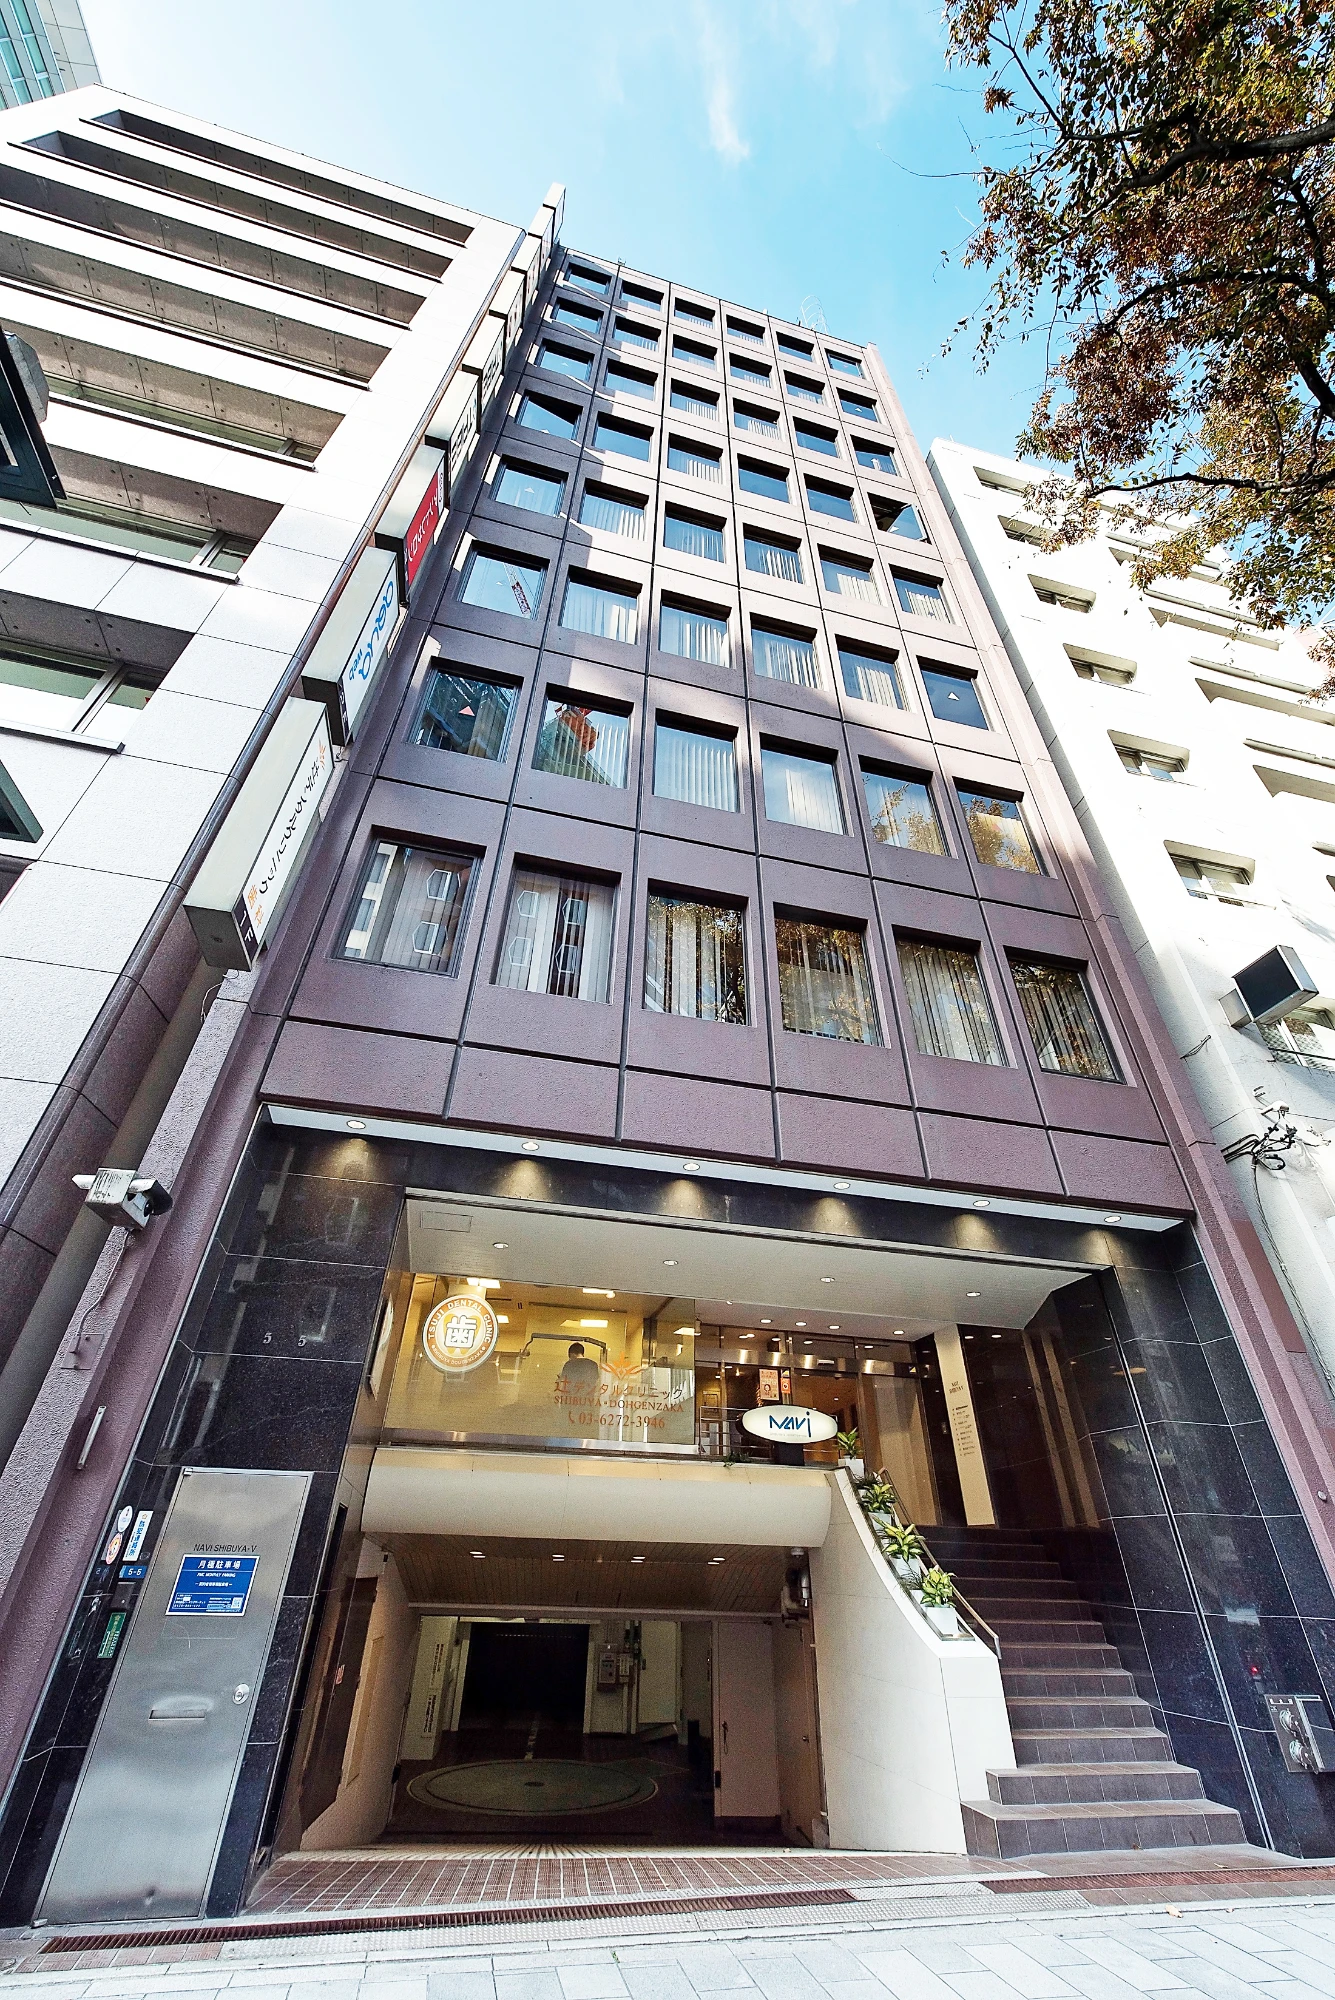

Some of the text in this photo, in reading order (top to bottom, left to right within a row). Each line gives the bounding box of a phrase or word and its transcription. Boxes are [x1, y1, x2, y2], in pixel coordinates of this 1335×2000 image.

[428, 1299, 493, 1343] TSUJI DENTAL CLINIC
[444, 1315, 477, 1348] 歯
[554, 1374, 683, 1400] 辻デンタルクリニック
[578, 1411, 665, 1428] 03-6272-3946
[193, 1543, 213, 1552] NAVI
